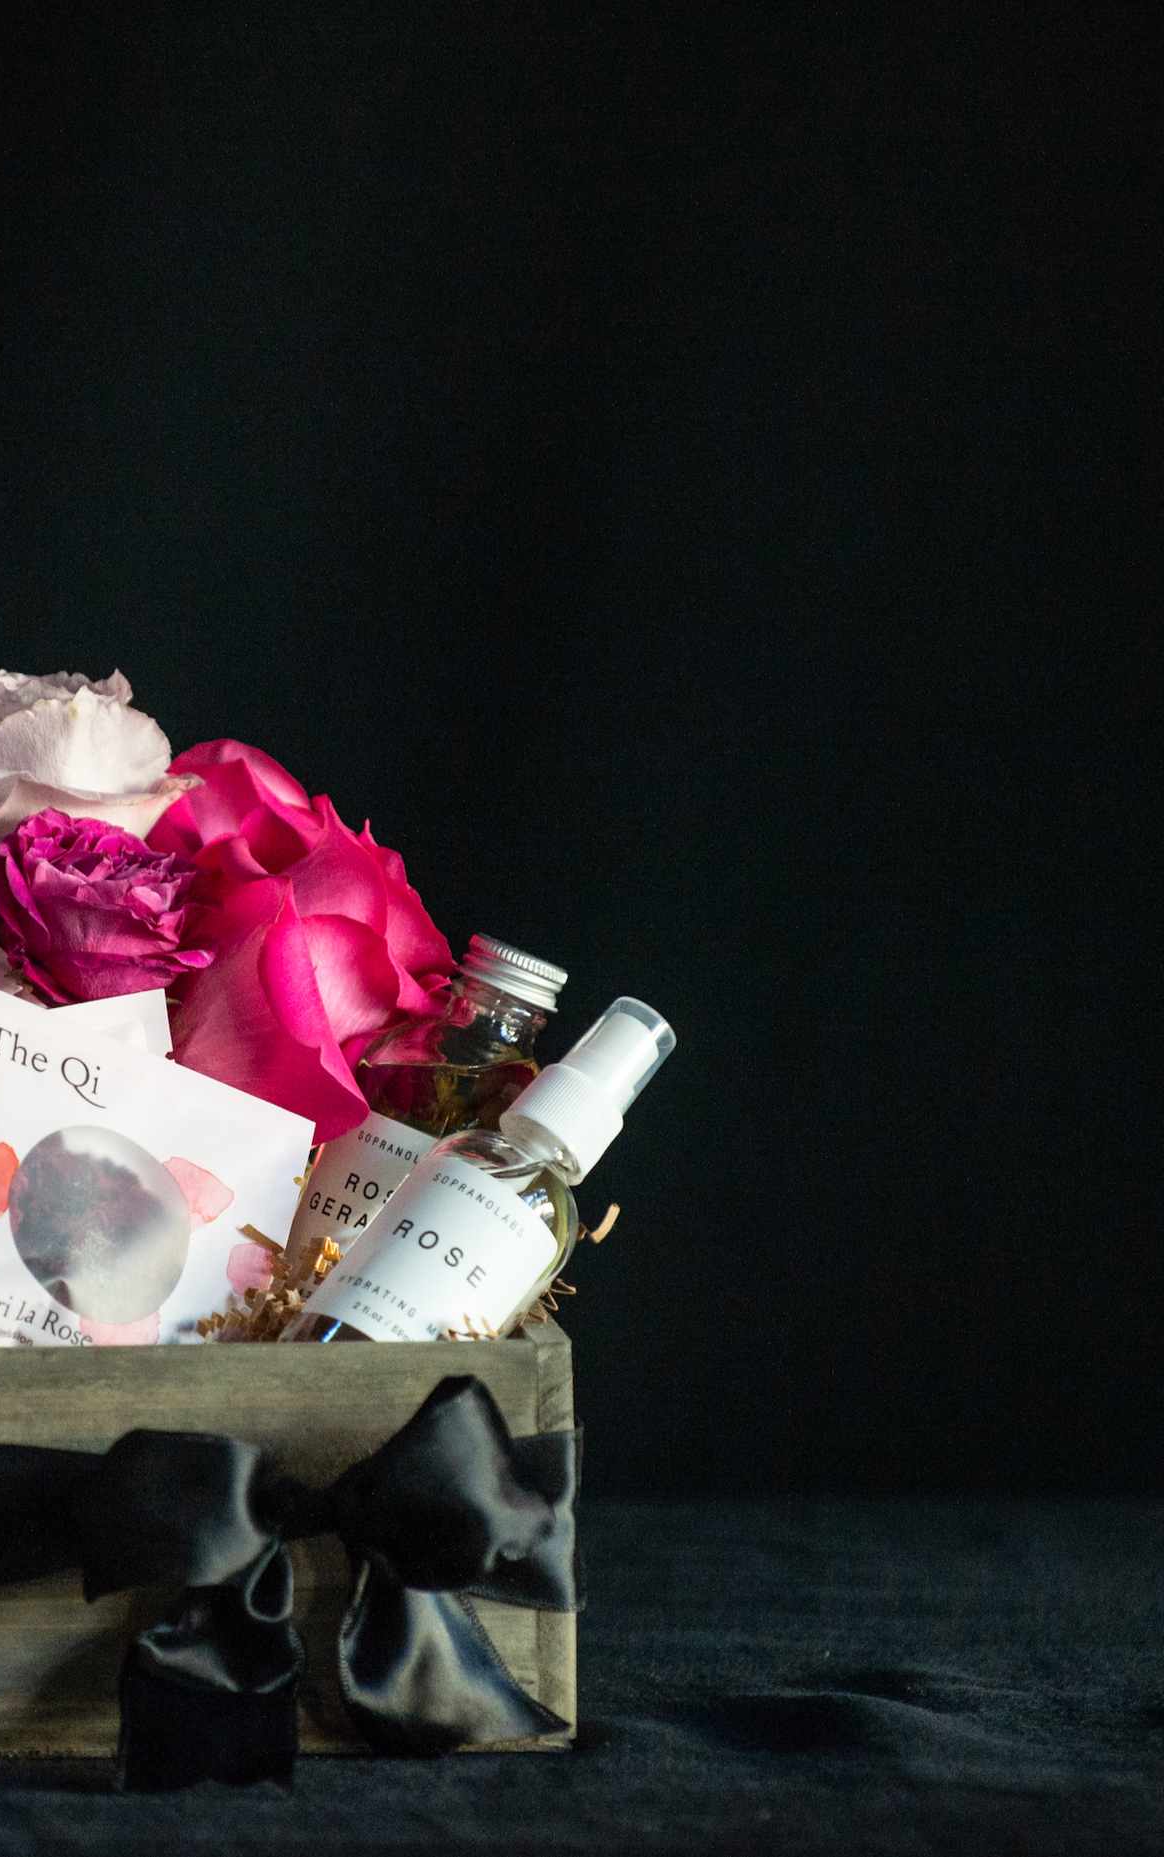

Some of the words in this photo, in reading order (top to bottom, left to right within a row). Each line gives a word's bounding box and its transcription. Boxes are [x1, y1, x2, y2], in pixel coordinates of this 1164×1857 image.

[60, 1056, 107, 1109] Qi
[309, 1191, 369, 1230] GERA
[432, 1172, 526, 1238] SOPRANOLABS
[392, 1218, 488, 1289] ROSE
[338, 1274, 417, 1318] HYDRATING
[15, 1301, 36, 1324] la
[41, 1309, 93, 1347] Rose
